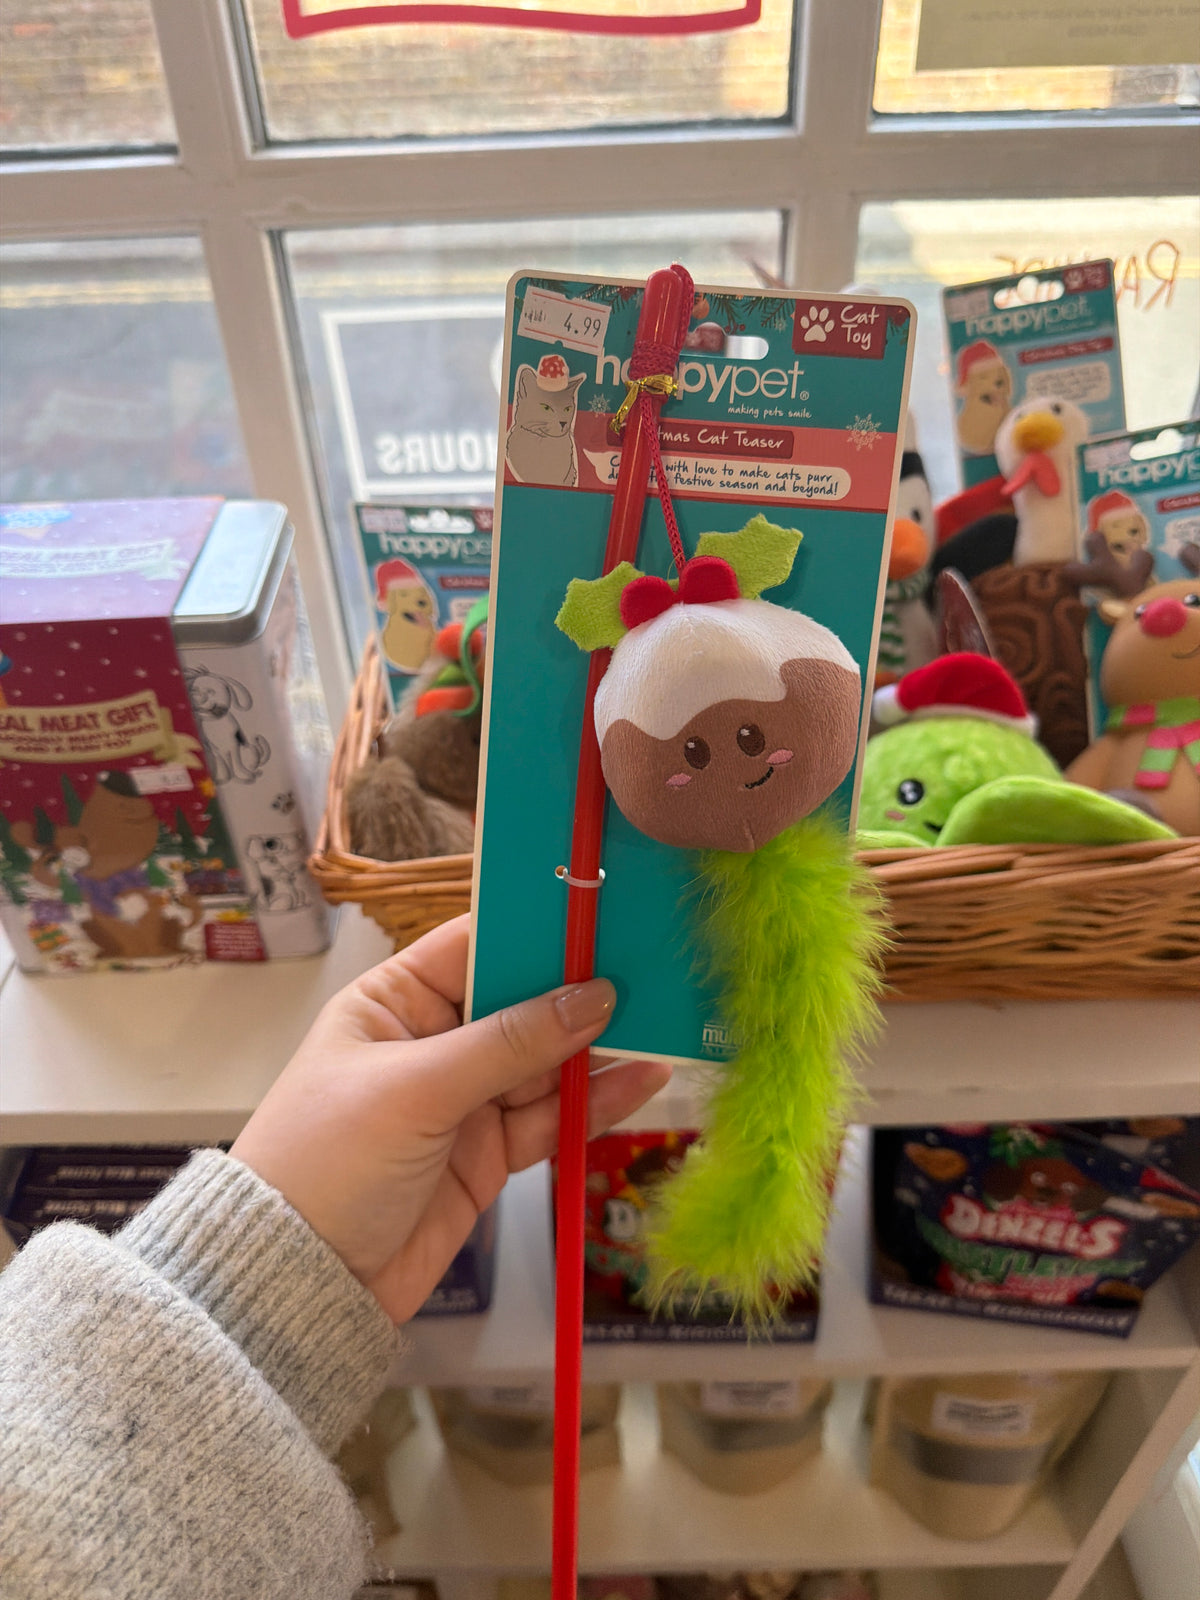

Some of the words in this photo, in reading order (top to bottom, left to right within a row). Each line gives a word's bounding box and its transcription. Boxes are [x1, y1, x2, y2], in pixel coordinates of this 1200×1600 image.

[564, 312, 602, 338] 4.99
[841, 305, 880, 325] Cat
[841, 324, 872, 351] Toy
[595, 347, 805, 404] hpypet
[727, 403, 760, 419] making
[763, 405, 784, 420] pets
[788, 407, 812, 419] smile
[697, 428, 729, 446] Cat
[733, 430, 784, 449] Teaser
[665, 459, 689, 473] with
[695, 461, 718, 475] love
[722, 463, 734, 476] to
[740, 464, 771, 479] make
[776, 467, 802, 480] cats
[807, 473, 833, 486] purr
[674, 472, 715, 488] festive
[719, 480, 760, 490] season
[765, 479, 787, 492] and
[792, 481, 839, 498] beyond!
[40, 712, 101, 732] MEAT
[106, 701, 155, 727] GIFT
